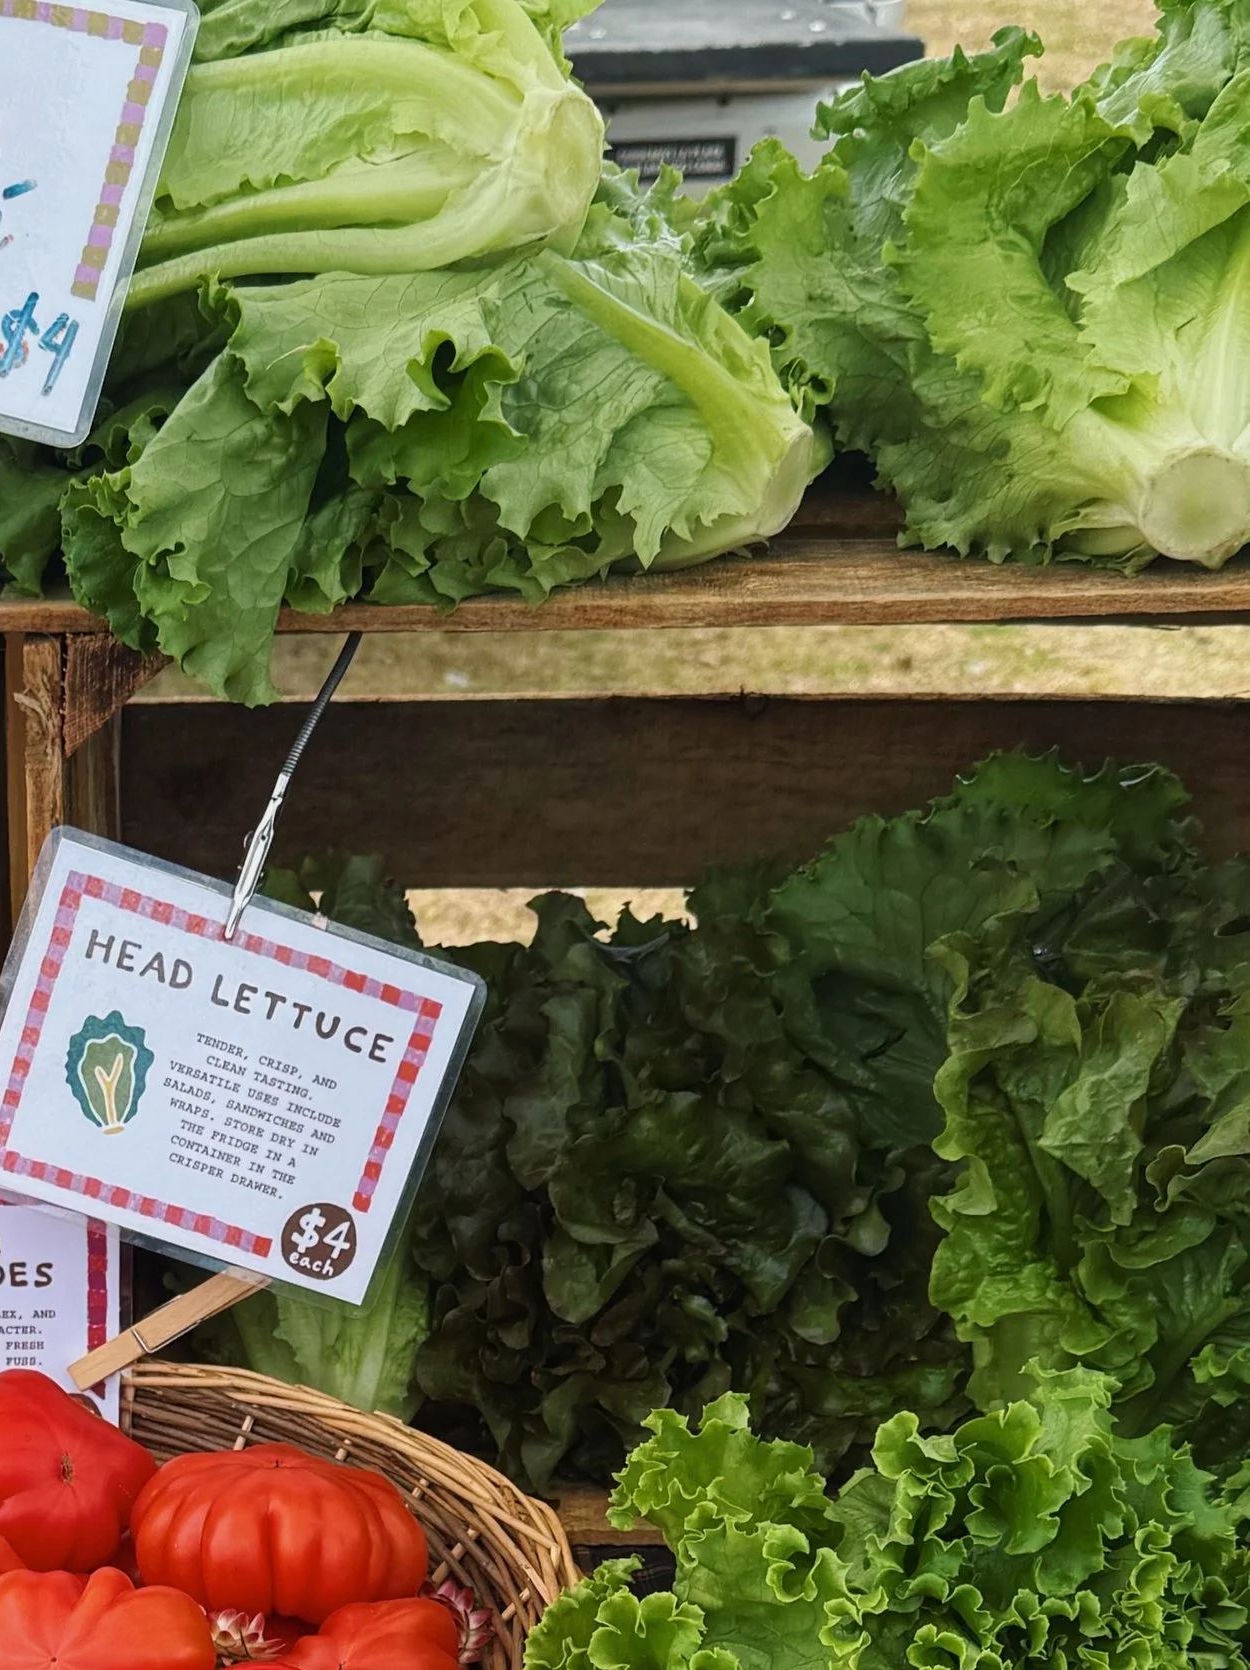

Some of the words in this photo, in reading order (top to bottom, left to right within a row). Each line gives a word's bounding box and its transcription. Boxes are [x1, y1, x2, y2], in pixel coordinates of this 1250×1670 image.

[84, 929, 193, 989] HEAD
[210, 974, 395, 1063] LETTUCE
[197, 1033, 248, 1060] TENDER,
[258, 1055, 302, 1079] CRISP,
[312, 1074, 337, 1090] AND
[206, 1055, 247, 1076] CLEAN
[254, 1071, 312, 1100] TASTING.
[163, 1077, 215, 1104] SALADS,
[226, 1099, 305, 1133] SANDWICHES
[310, 1129, 335, 1144] AND
[170, 1060, 241, 1093] VERSATILE
[248, 1088, 279, 1106] USES
[286, 1102, 341, 1128] INCLUDE
[170, 1097, 214, 1121] WRAPS.
[224, 1117, 265, 1138] STORE
[270, 1132, 296, 1148] DRY
[302, 1144, 319, 1156] IN
[181, 1119, 205, 1136] THE
[210, 1130, 259, 1154] FRIDGE
[265, 1149, 282, 1162] IN
[287, 1157, 296, 1168] A
[169, 1152, 224, 1179] CRISPER
[230, 1173, 282, 1199] DRAWER.
[170, 1135, 241, 1166] CONTAINER
[248, 1161, 265, 1174] IN
[272, 1169, 296, 1185] THE
[291, 1207, 351, 1259] $4
[288, 1251, 335, 1277] each
[32, 1310, 56, 1319] AND
[6, 1341, 44, 1350] FRESH
[6, 1356, 42, 1366] FUSS.
